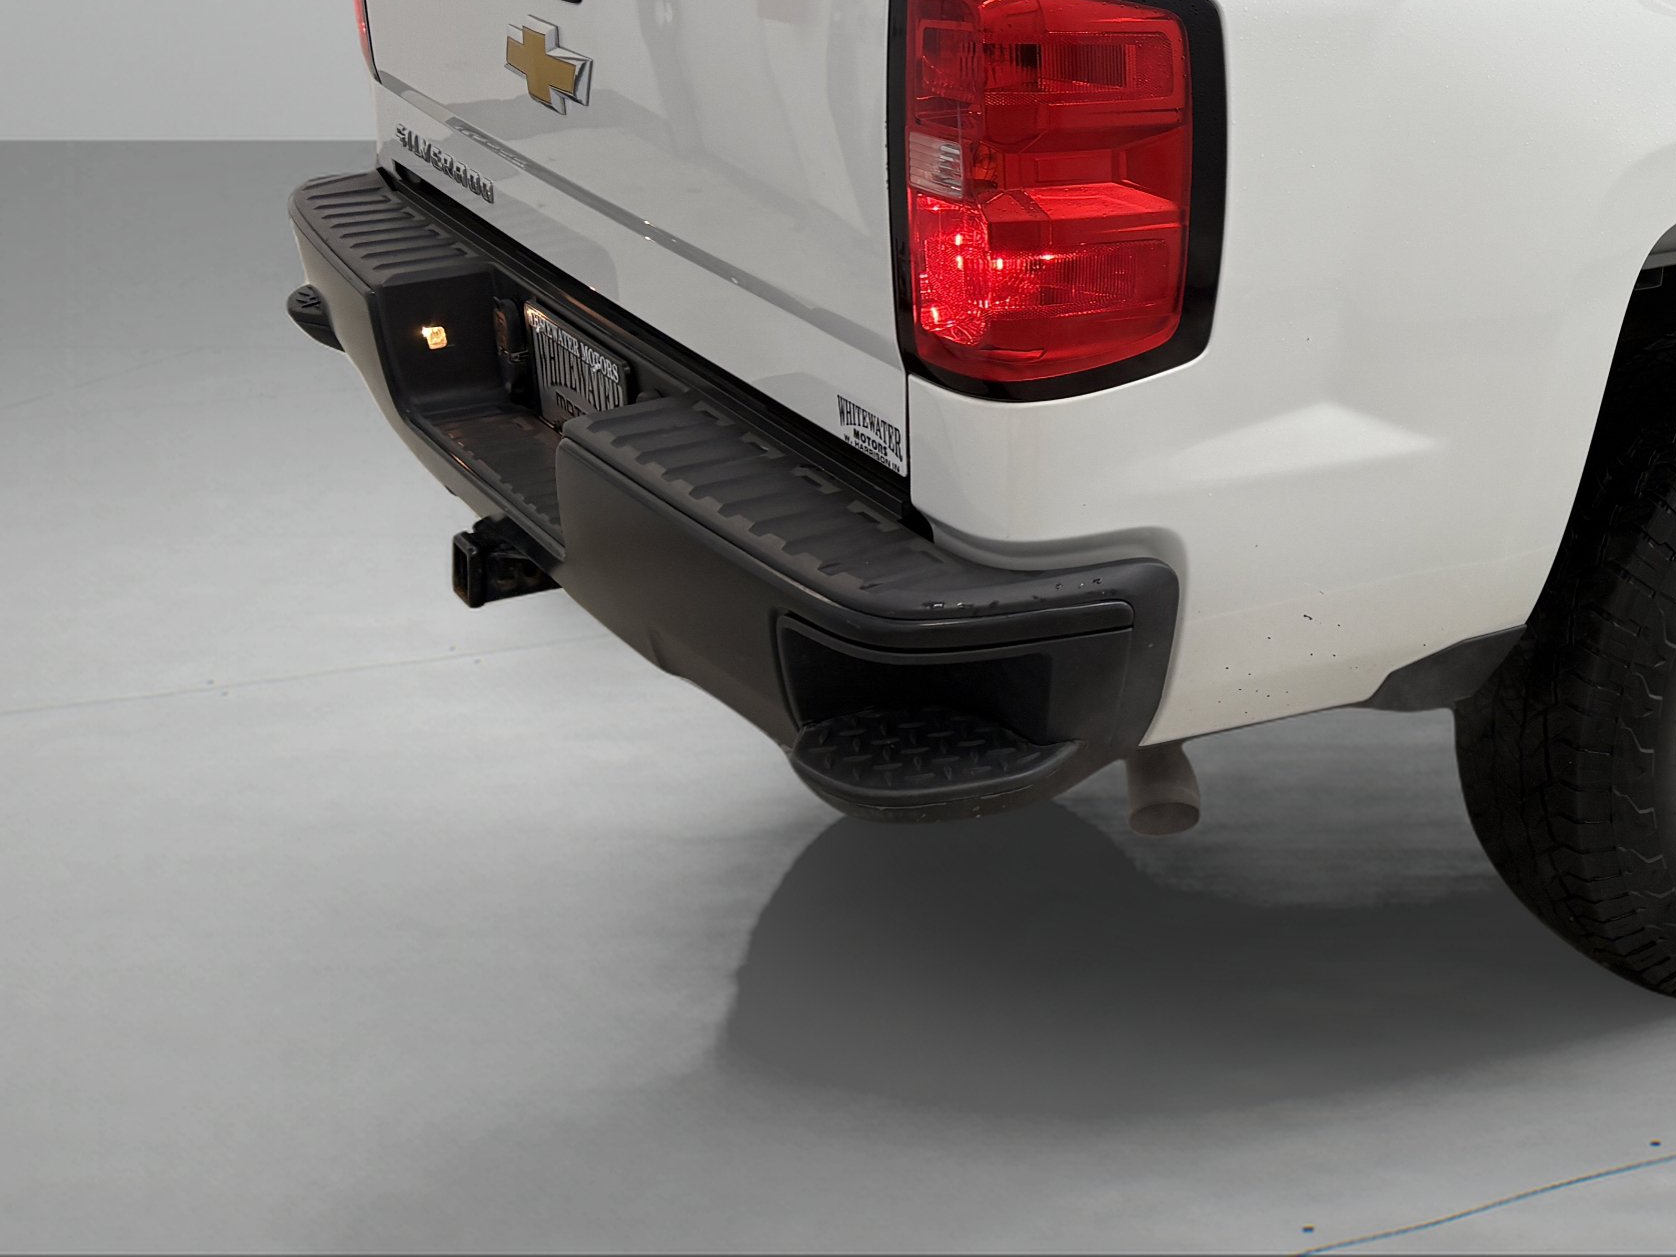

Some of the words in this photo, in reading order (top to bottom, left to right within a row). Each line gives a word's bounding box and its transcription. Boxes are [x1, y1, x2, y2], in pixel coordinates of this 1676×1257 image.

[396, 123, 494, 204] SILVERADO
[529, 310, 580, 359] WHTEWATER
[580, 342, 619, 383] MOTORS
[556, 392, 587, 418] MOT
[837, 394, 903, 462] WHITEWATER
[853, 428, 888, 457] MOTORS
